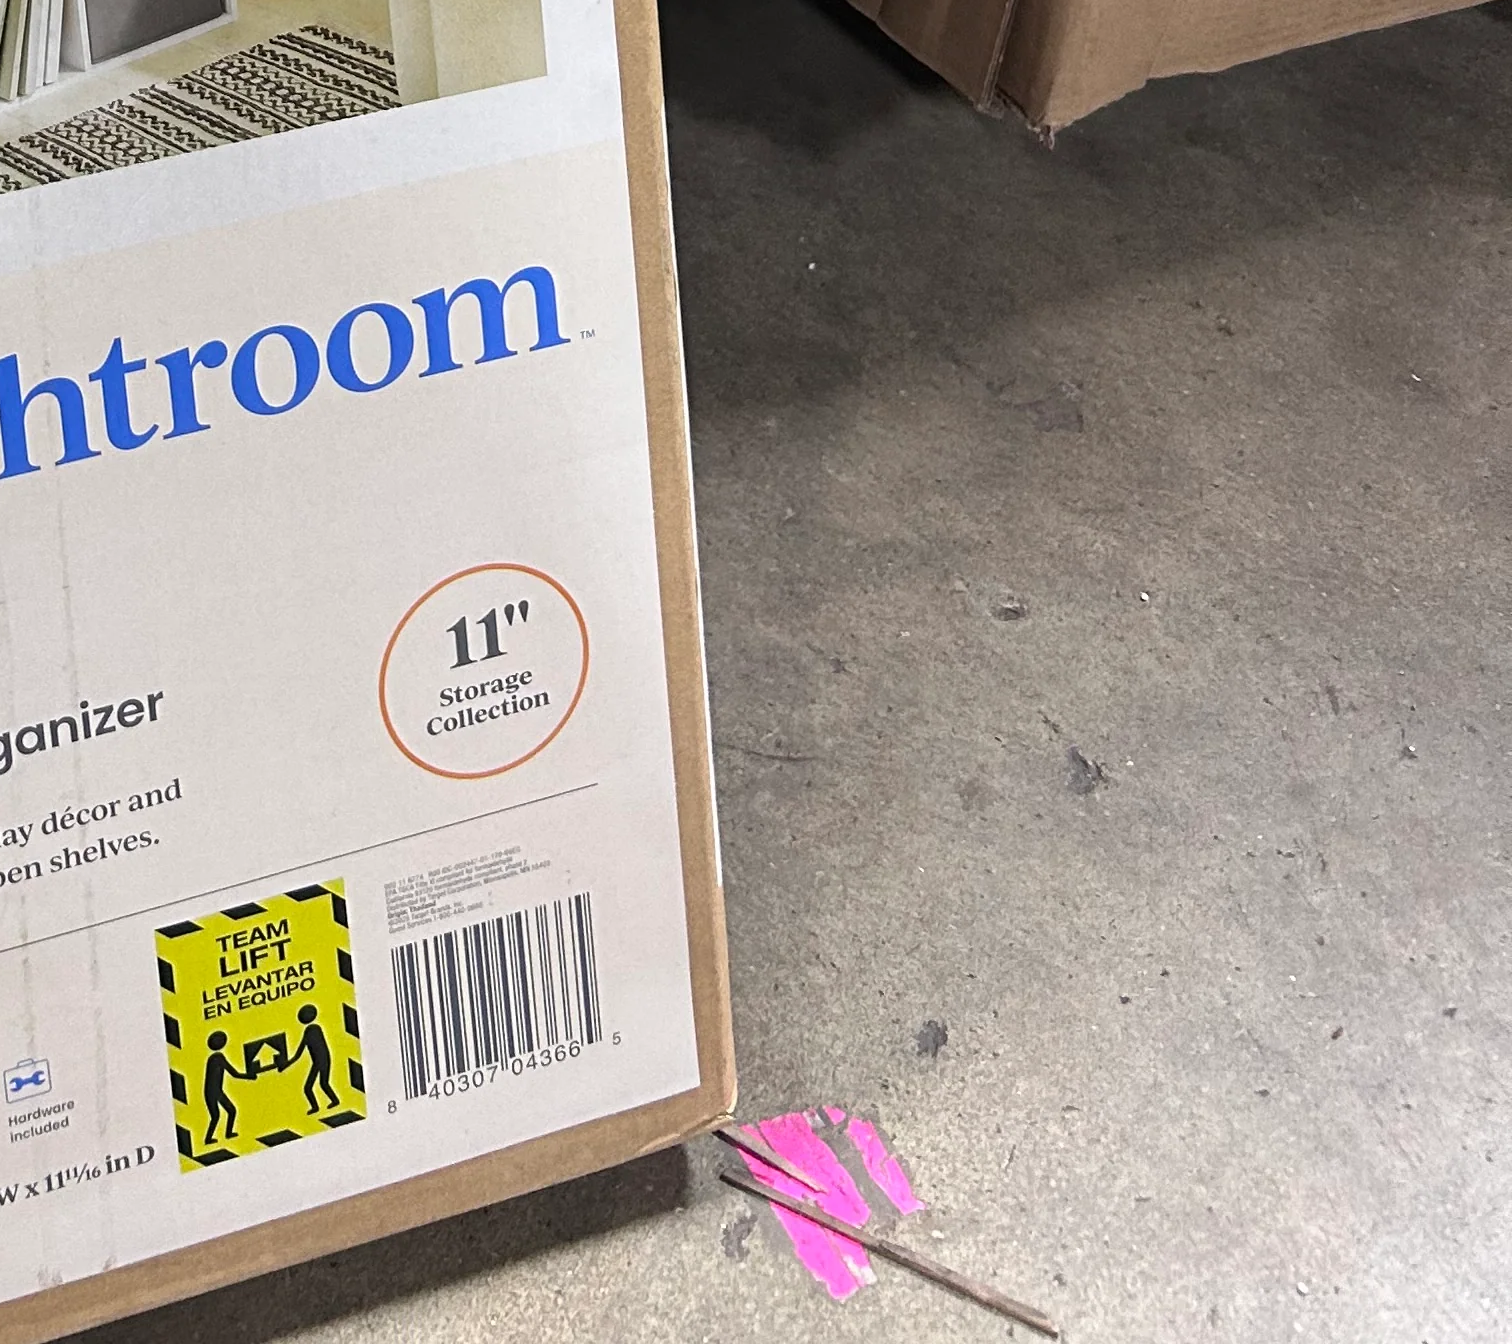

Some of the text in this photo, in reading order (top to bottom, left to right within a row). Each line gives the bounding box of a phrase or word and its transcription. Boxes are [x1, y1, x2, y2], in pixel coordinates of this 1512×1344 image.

[446, 599, 530, 670] 11"
[439, 670, 533, 708] Storage
[426, 691, 551, 736] Collection
[40, 798, 122, 835] décor
[128, 778, 183, 813] and
[48, 828, 161, 875] shelves.
[215, 919, 290, 953] TEAM
[219, 938, 292, 979] LIFT
[202, 960, 315, 1005] LEVANTAR
[203, 976, 316, 1021] EN EQUIPO
[387, 1031, 622, 1114] 8 40307 04366 5
[7, 1099, 75, 1128] Hardware
[9, 1116, 70, 1143] included
[24, 1181, 40, 1198] x
[105, 1153, 130, 1175] in
[135, 1144, 156, 1166] D
